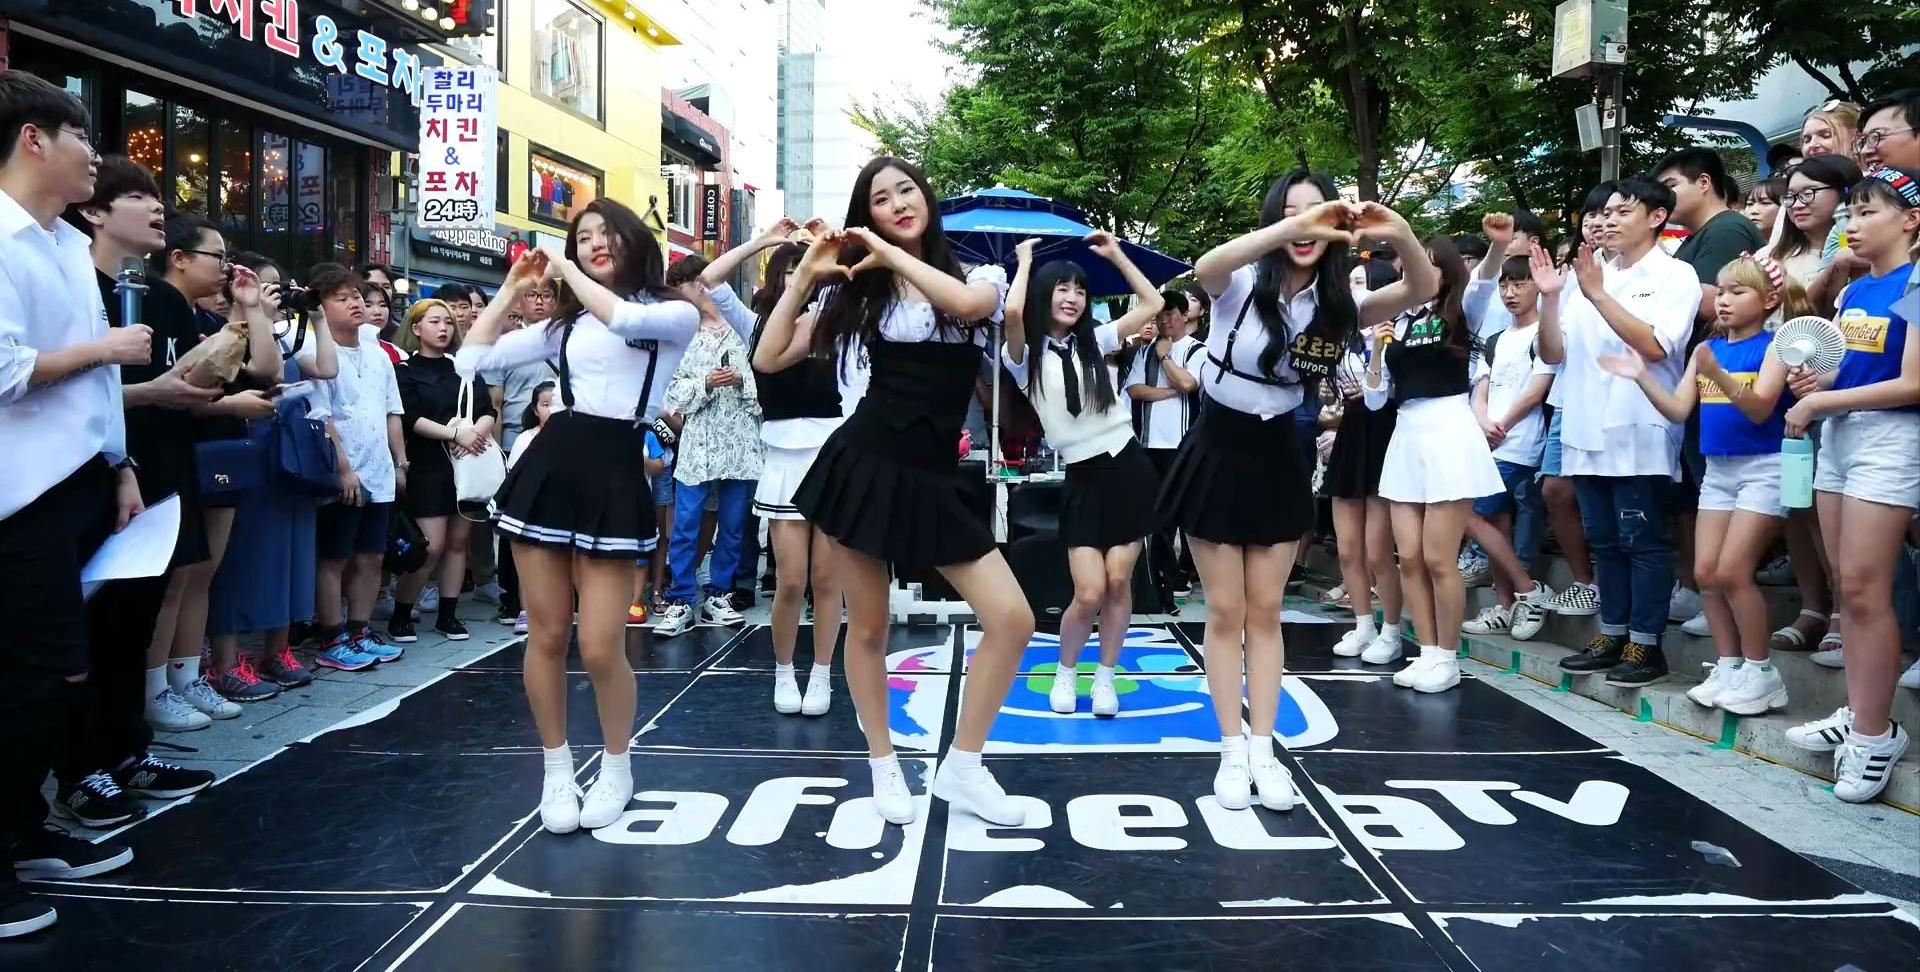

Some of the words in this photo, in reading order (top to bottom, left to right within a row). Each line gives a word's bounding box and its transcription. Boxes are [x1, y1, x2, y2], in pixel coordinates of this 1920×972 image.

[312, 14, 348, 75] &
[355, 29, 423, 108] 포차
[433, 70, 476, 90] 찰리
[426, 93, 483, 113] 두마리
[425, 117, 478, 144] 치킨
[444, 146, 461, 166] &
[424, 170, 479, 197] 포차
[424, 199, 479, 222] 24時
[707, 189, 716, 229] COFFEE
[436, 229, 478, 246] Apple
[479, 229, 508, 254] Ring
[1293, 357, 1329, 375] Aurora
